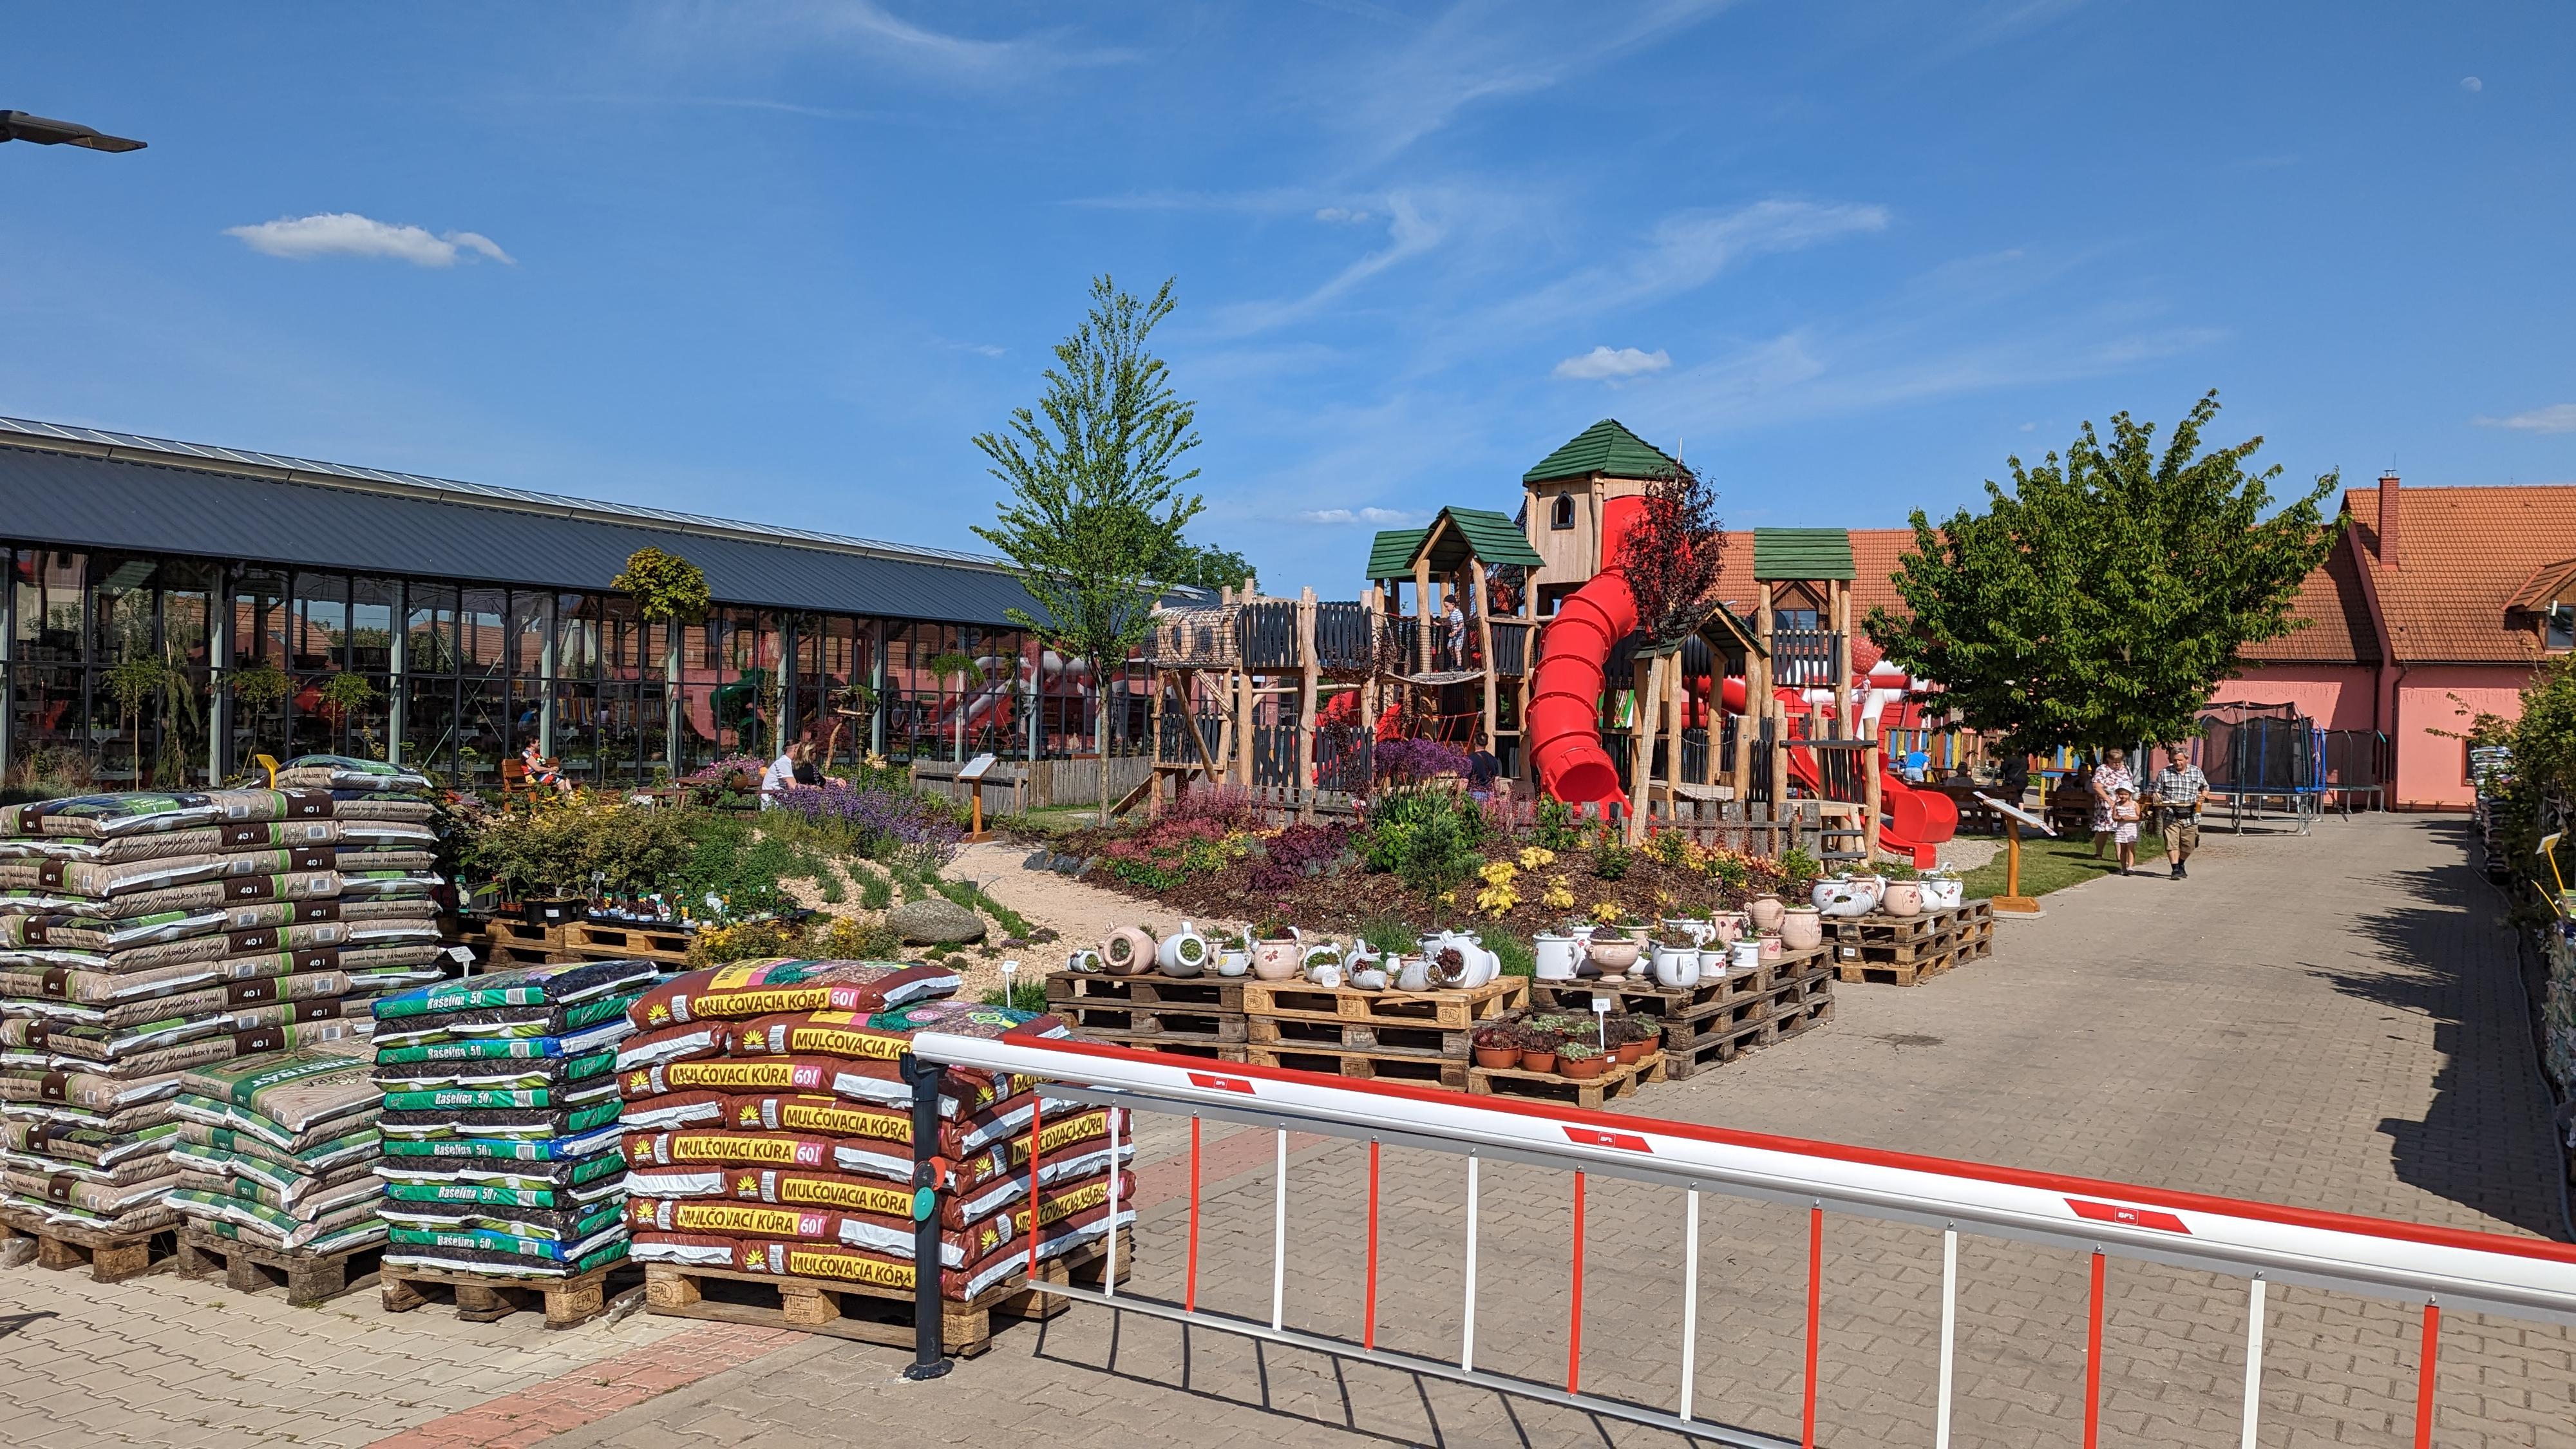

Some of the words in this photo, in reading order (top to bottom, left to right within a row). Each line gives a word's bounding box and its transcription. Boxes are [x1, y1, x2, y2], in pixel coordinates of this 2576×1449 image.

[382, 806, 417, 815] FARMÁRSKY
[384, 855, 419, 864] FARMÁRSKY
[387, 951, 422, 960] FARMÁRSKY
[243, 989, 255, 998] 40
[427, 992, 465, 1010] Rašelina
[469, 991, 482, 1004] 50
[697, 994, 784, 1016] MULČOVACIA
[787, 990, 826, 1009] KÔRA
[1247, 997, 1260, 1007] EPAL
[649, 1015, 671, 1026] garden
[1441, 1010, 1458, 1020] EPAL
[743, 1044, 766, 1052] garden
[795, 1030, 886, 1056] MULČOVACIA
[888, 1041, 911, 1058] KÔ
[167, 1048, 210, 1061] FARMÁŘSKÝ
[428, 1045, 466, 1061] Rašelina
[469, 1045, 481, 1056] 50
[673, 1065, 751, 1084] MULČOVACÍ
[752, 1066, 788, 1084] KŮRA
[630, 1084, 650, 1094] garden
[435, 1091, 473, 1106] Rašelina
[477, 1092, 489, 1105] 50
[740, 1119, 761, 1127] garden
[786, 1108, 867, 1133] MULČOVACIA
[871, 1117, 907, 1139] KÔRA
[676, 1137, 751, 1158] MULČOVACÍ
[753, 1140, 791, 1159] KŮRA
[1016, 1121, 1077, 1161] MUČOVACÍ
[433, 1143, 472, 1157] Rašelina
[475, 1143, 488, 1156] 50
[438, 1185, 477, 1200] Rašelina
[482, 1187, 493, 1200] 50
[737, 1189, 759, 1198] garden
[785, 1181, 867, 1205] MULČOVACIA
[870, 1191, 907, 1213] KÔRA
[680, 1208, 755, 1229] MULČOVACÍ
[758, 1212, 793, 1233] KŮRA
[437, 1235, 475, 1249] Rašelina
[478, 1236, 491, 1249] 50
[793, 1255, 872, 1278] MULČOVACIA
[875, 1265, 911, 1284] KÔRA
[576, 1294, 598, 1309] EPAL
